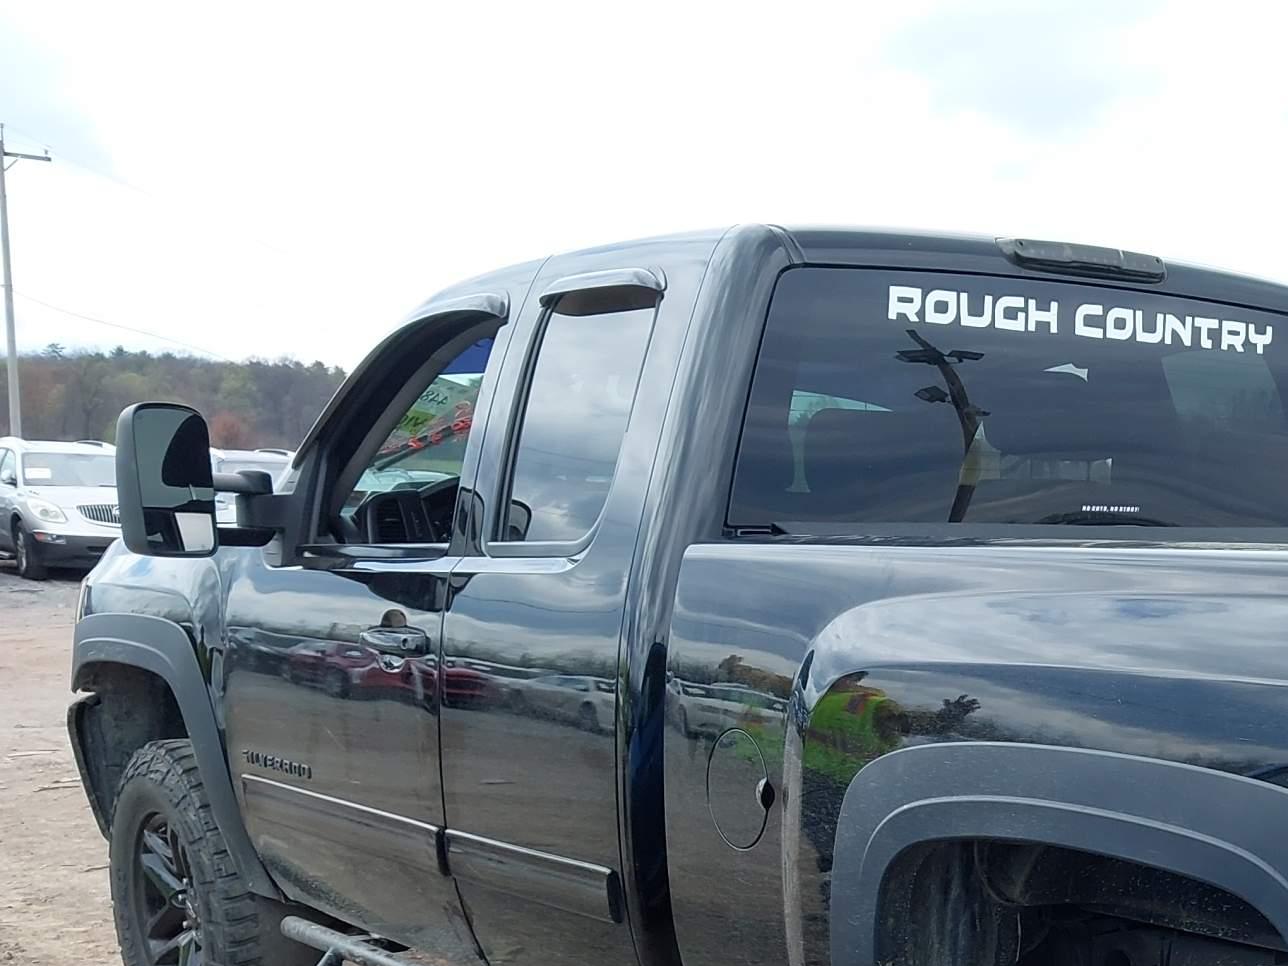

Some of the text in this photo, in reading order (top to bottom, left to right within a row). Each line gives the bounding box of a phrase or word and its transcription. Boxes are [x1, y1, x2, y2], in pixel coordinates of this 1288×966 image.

[887, 284, 1274, 355] ROUGH COUNTRY
[240, 748, 313, 781] SILVERADO
